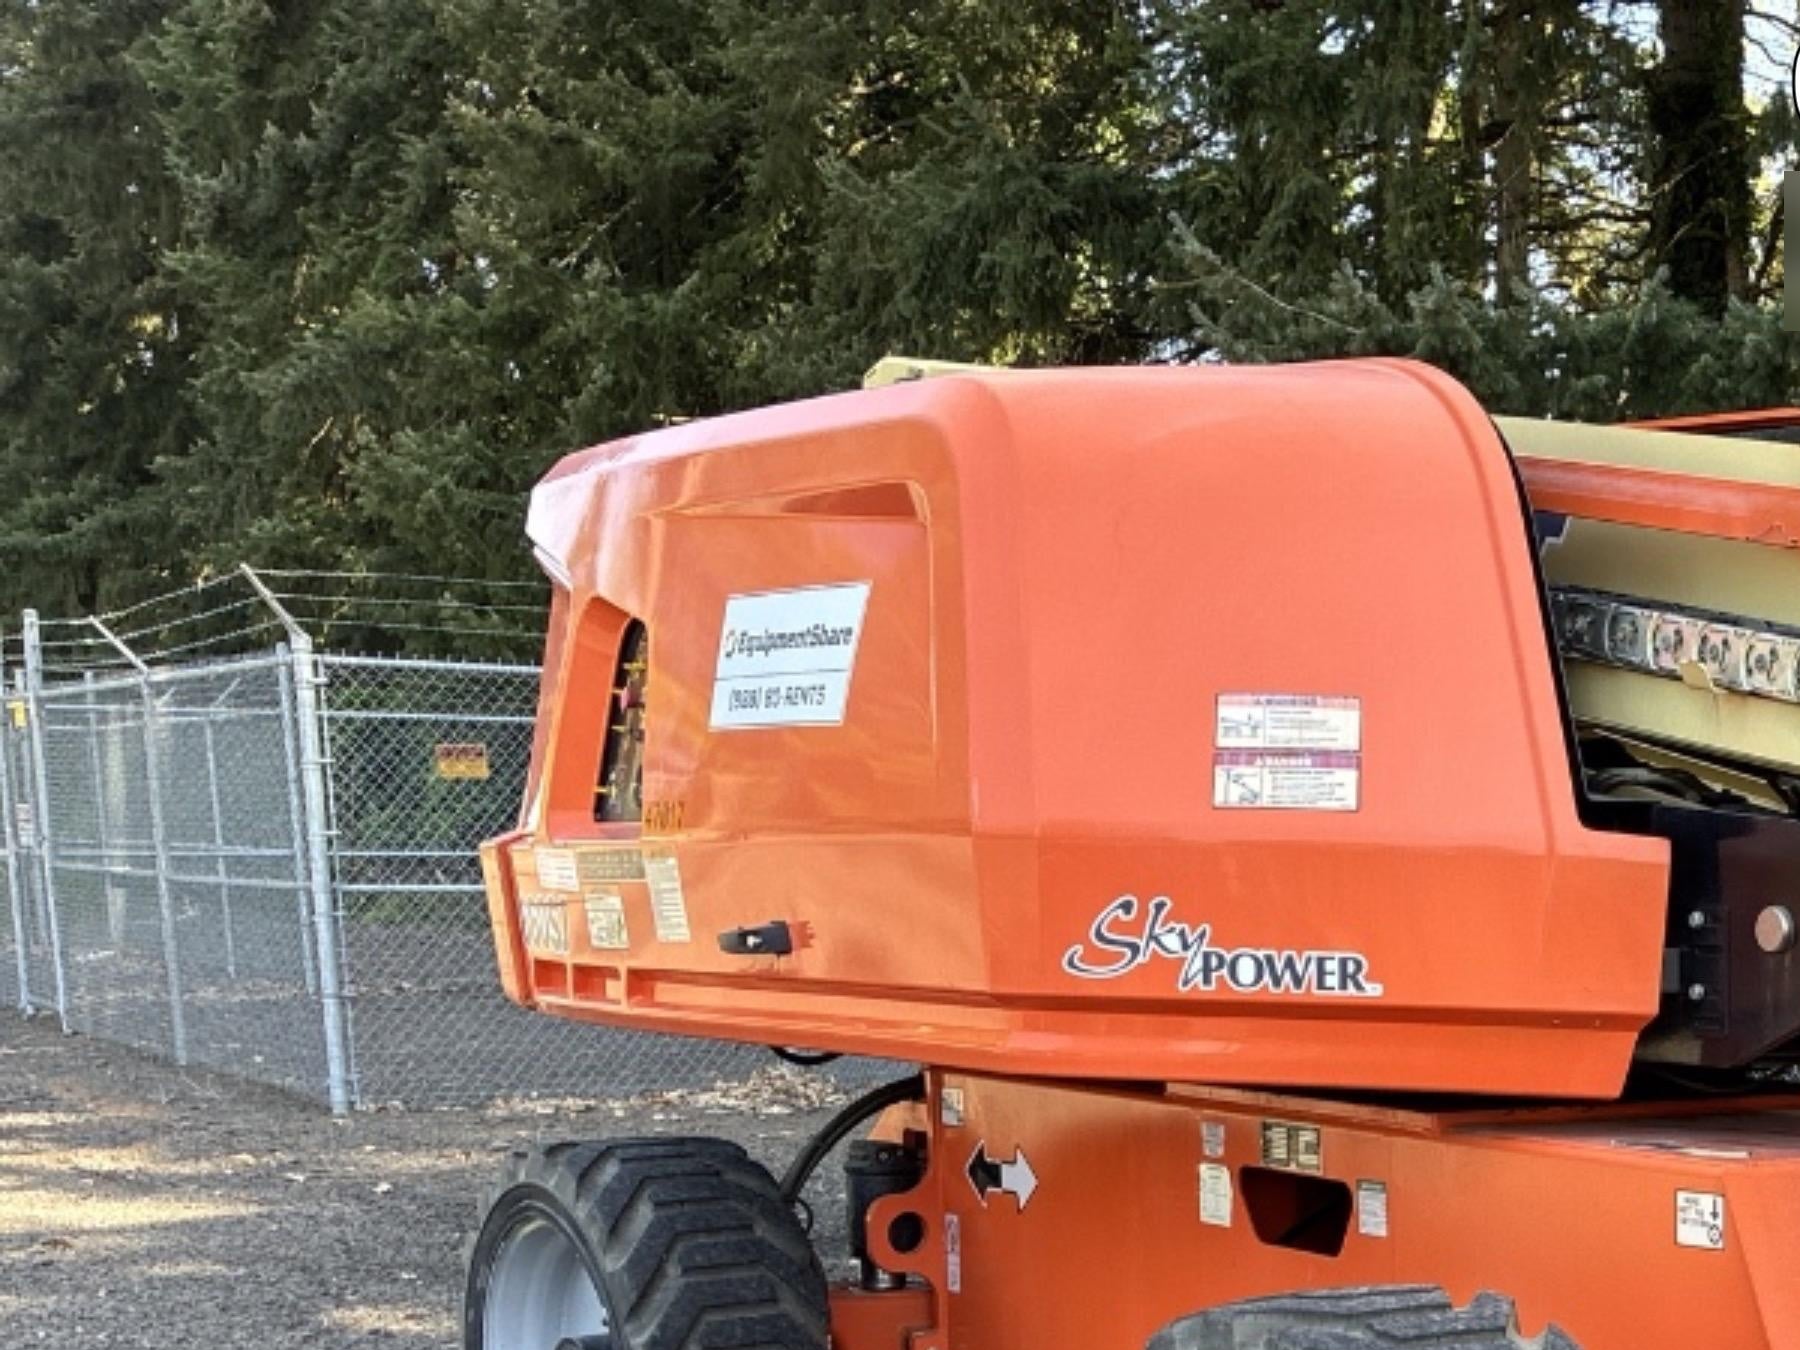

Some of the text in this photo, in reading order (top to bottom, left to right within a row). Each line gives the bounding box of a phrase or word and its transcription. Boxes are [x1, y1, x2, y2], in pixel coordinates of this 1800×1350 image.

[737, 623, 854, 658] EquipmentShare
[1065, 897, 1368, 993] Sky POWER
